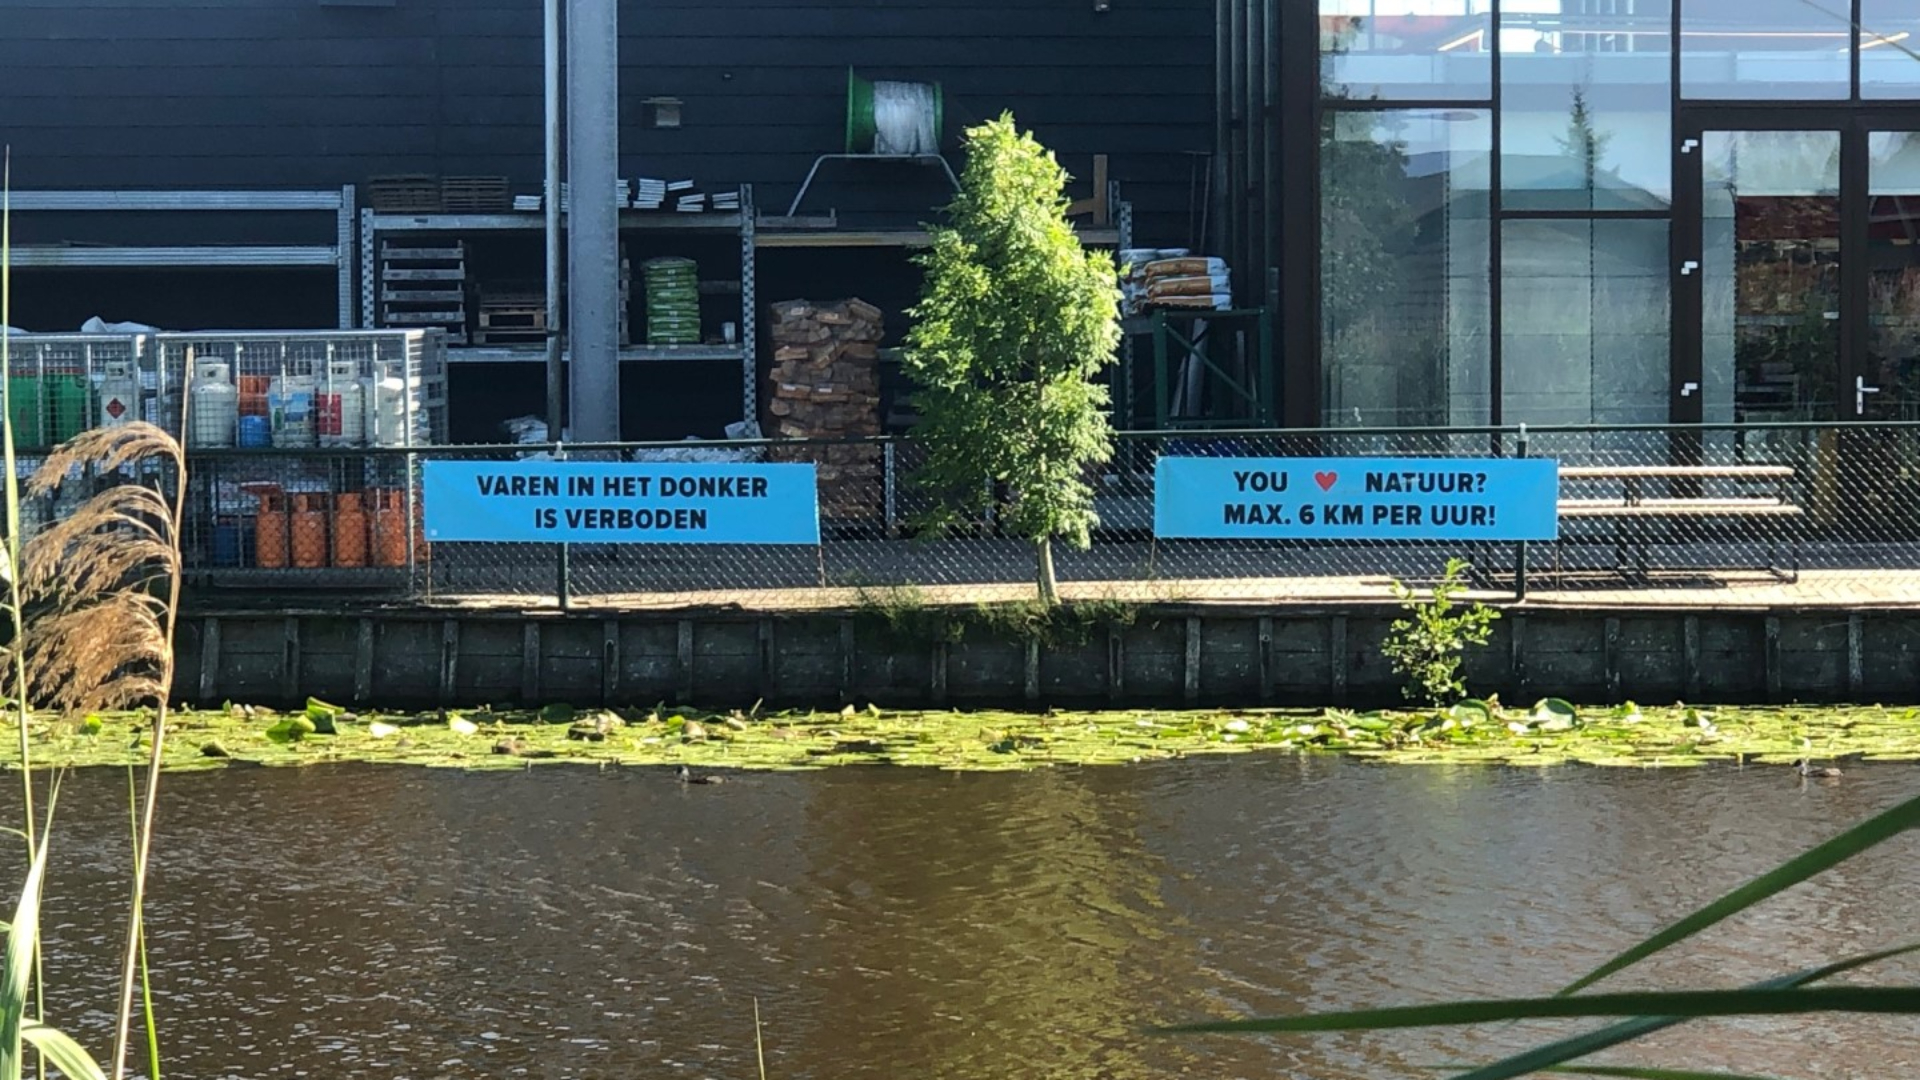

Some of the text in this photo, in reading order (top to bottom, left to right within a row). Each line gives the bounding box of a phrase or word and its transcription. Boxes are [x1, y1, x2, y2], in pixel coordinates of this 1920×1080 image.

[477, 475, 768, 498] VAREN IN HET DONKER
[1233, 471, 1487, 493] YOU NATUUR?
[535, 508, 707, 530] IS VERBODEN
[1224, 503, 1495, 526] MAX. 6 KM PER UUR!
